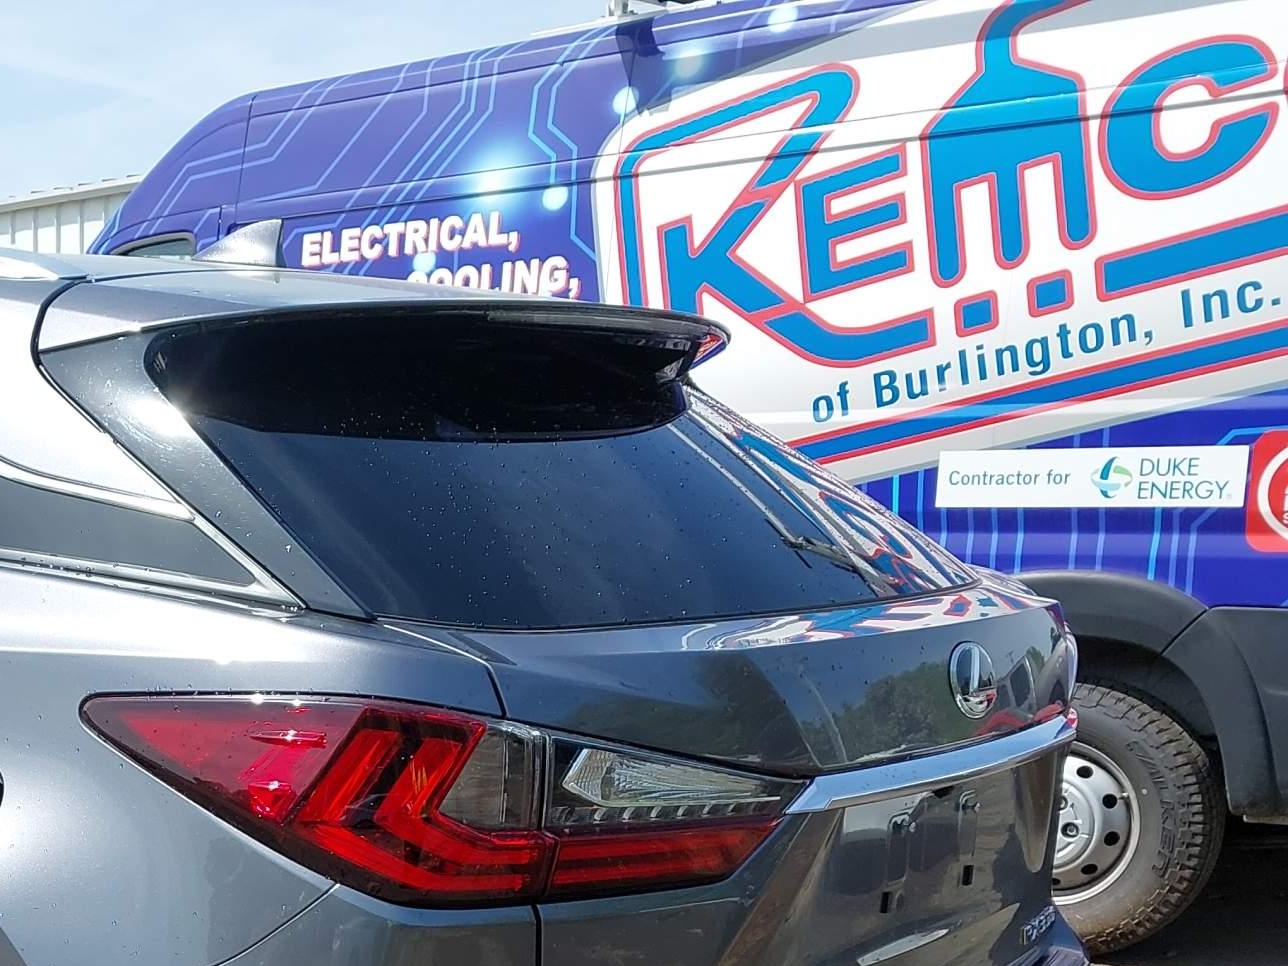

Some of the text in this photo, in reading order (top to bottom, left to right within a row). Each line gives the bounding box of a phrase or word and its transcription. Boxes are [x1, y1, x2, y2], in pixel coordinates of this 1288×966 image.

[301, 210, 520, 268] ELECTRICAL,
[407, 256, 581, 300] OOLING,
[813, 280, 1281, 423] of Burlington, Inc.
[948, 468, 1071, 486] Contractor for
[1139, 457, 1200, 477] DUKE
[1137, 479, 1230, 500] ENERGY
